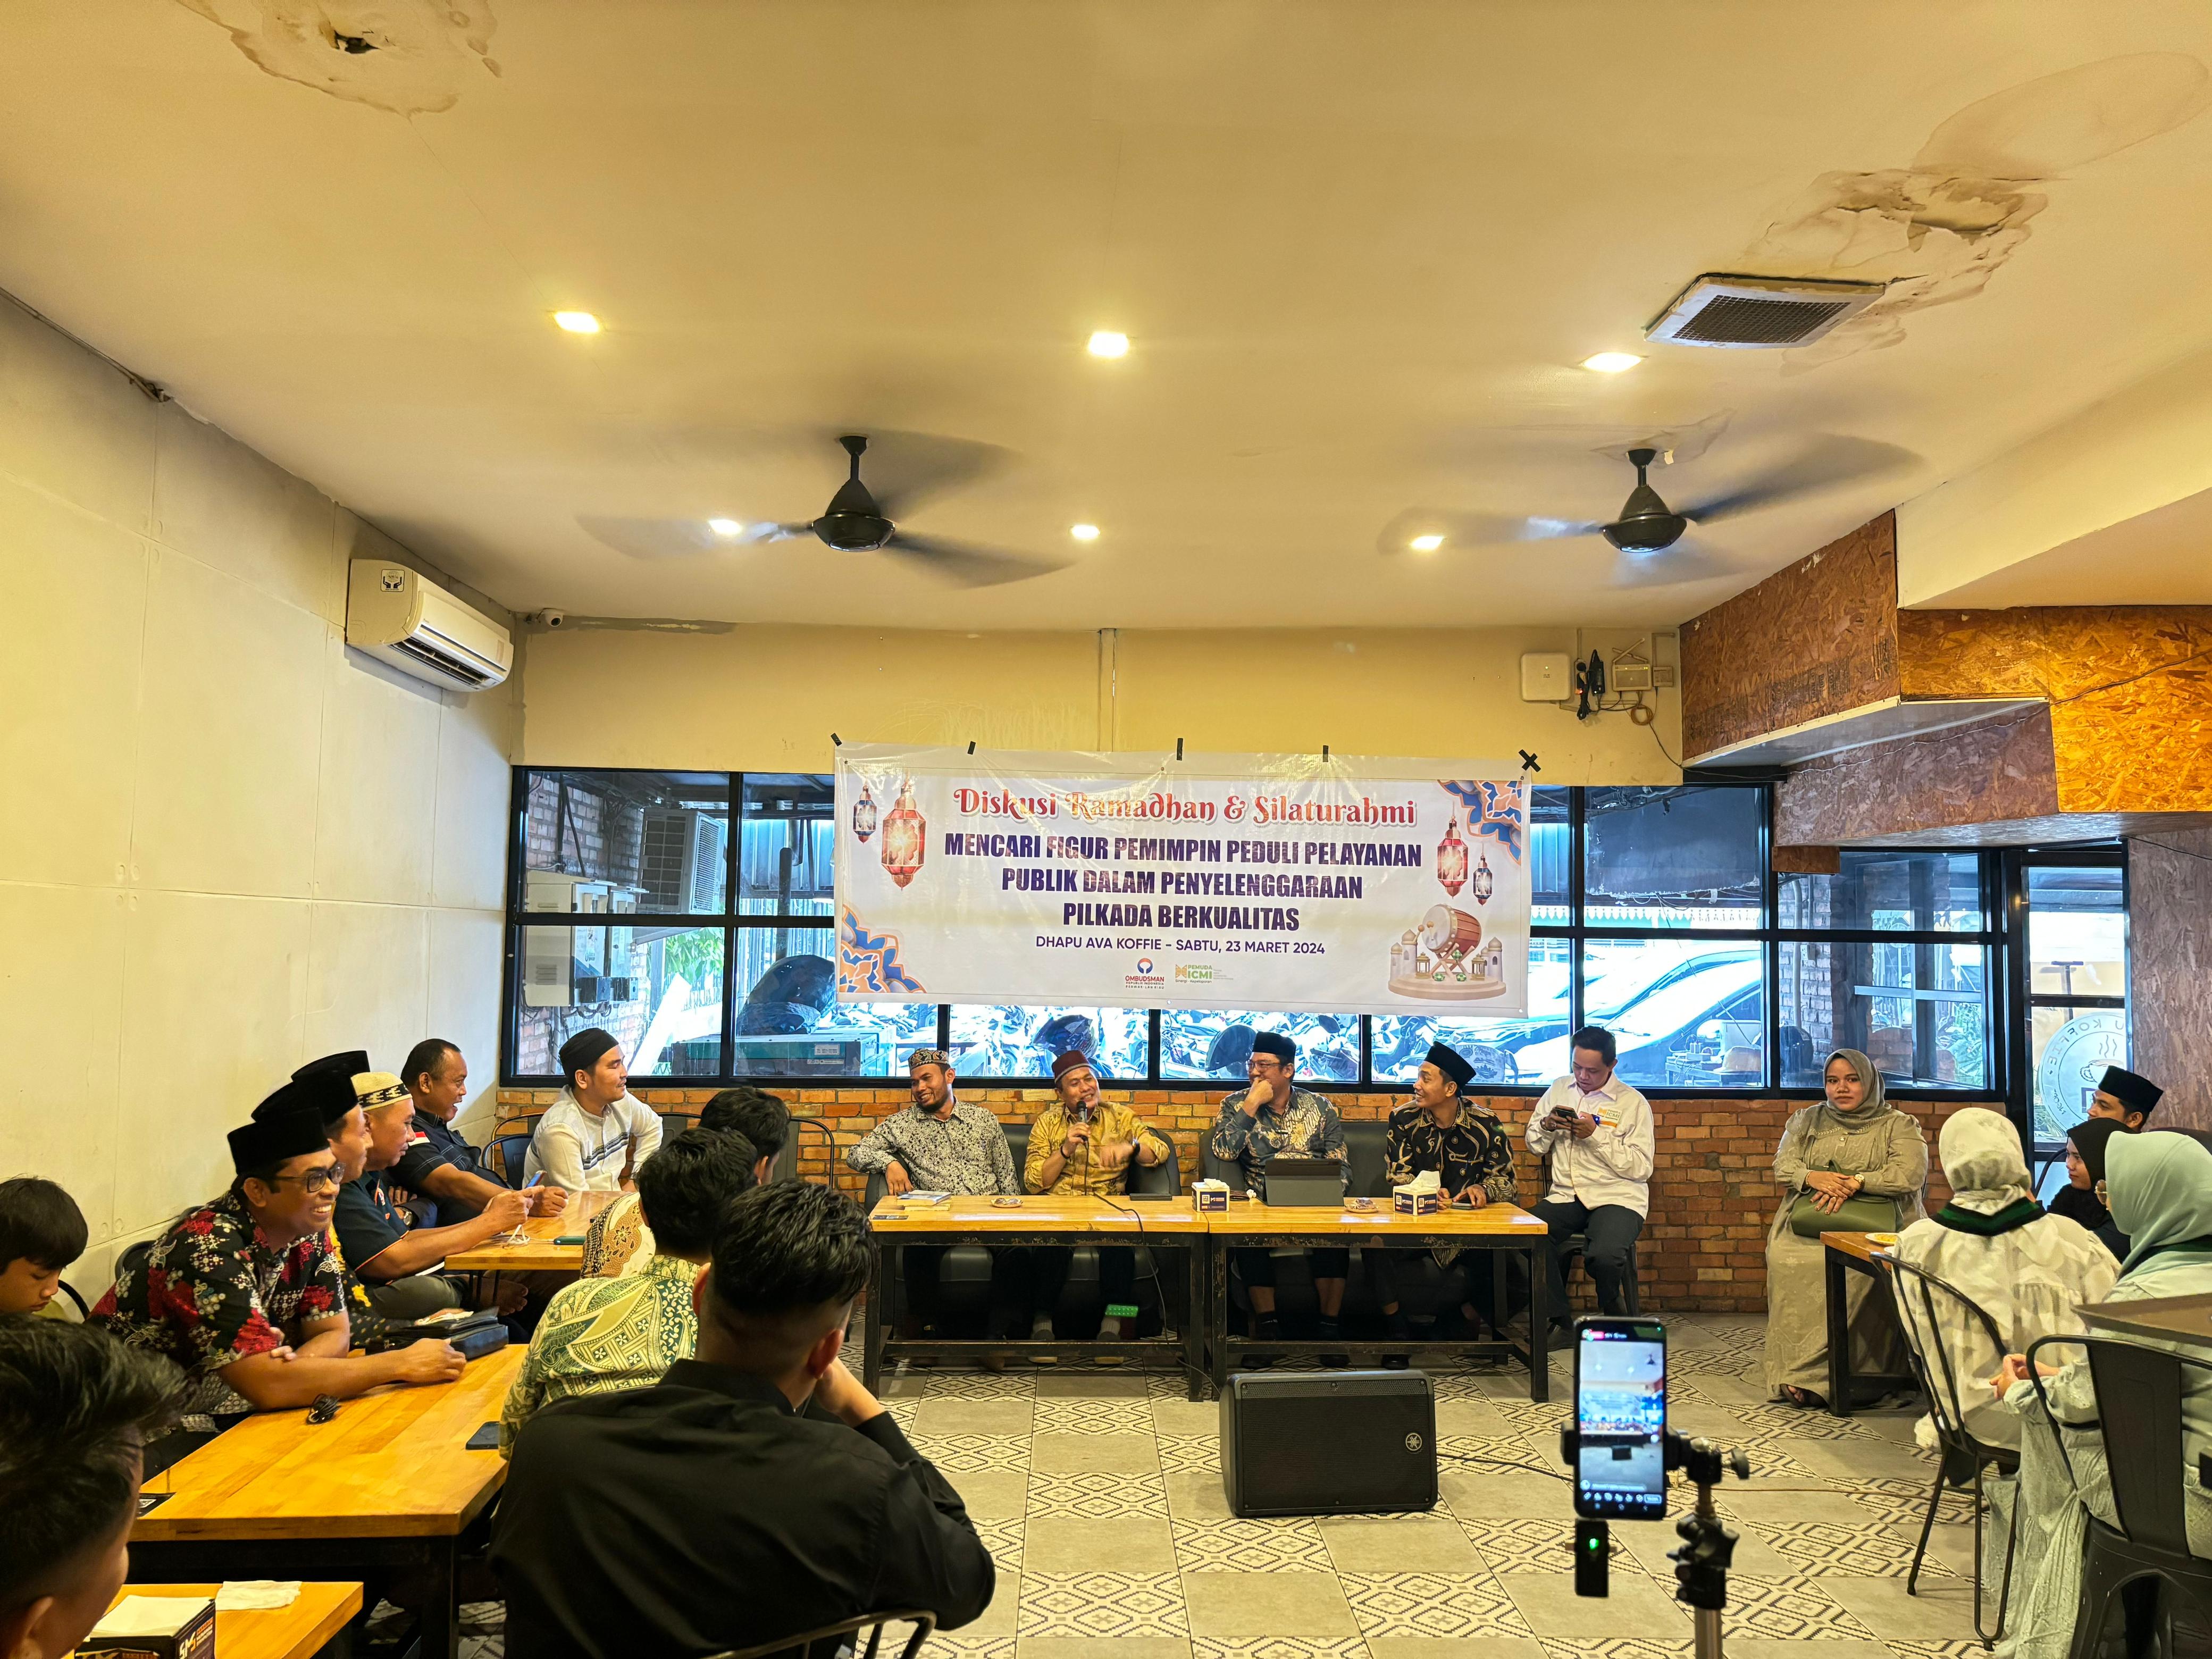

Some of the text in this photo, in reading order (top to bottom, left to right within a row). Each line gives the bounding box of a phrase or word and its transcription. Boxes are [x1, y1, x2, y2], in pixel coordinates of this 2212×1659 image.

[954, 789, 1413, 823] Diskusi Ramadhan & Silaturahmi
[945, 833, 1421, 866] MENCARI FIGUR PEMIMPIN PEDULI PELAYANAN
[1002, 868, 1362, 899] PUBLIK DALAM PENYELENGGARAAN
[1064, 903, 1298, 931] PILKADA BERKUALITAS
[1037, 936, 1082, 948] DHAPU
[1086, 937, 1112, 948] AVA
[1117, 939, 1161, 949] KOFFIE
[1176, 940, 1221, 953] SABTU,
[1226, 941, 1240, 951] 23
[1245, 942, 1289, 953] MARET
[1293, 943, 1325, 953] 2024
[1187, 970, 1212, 979] ICMI
